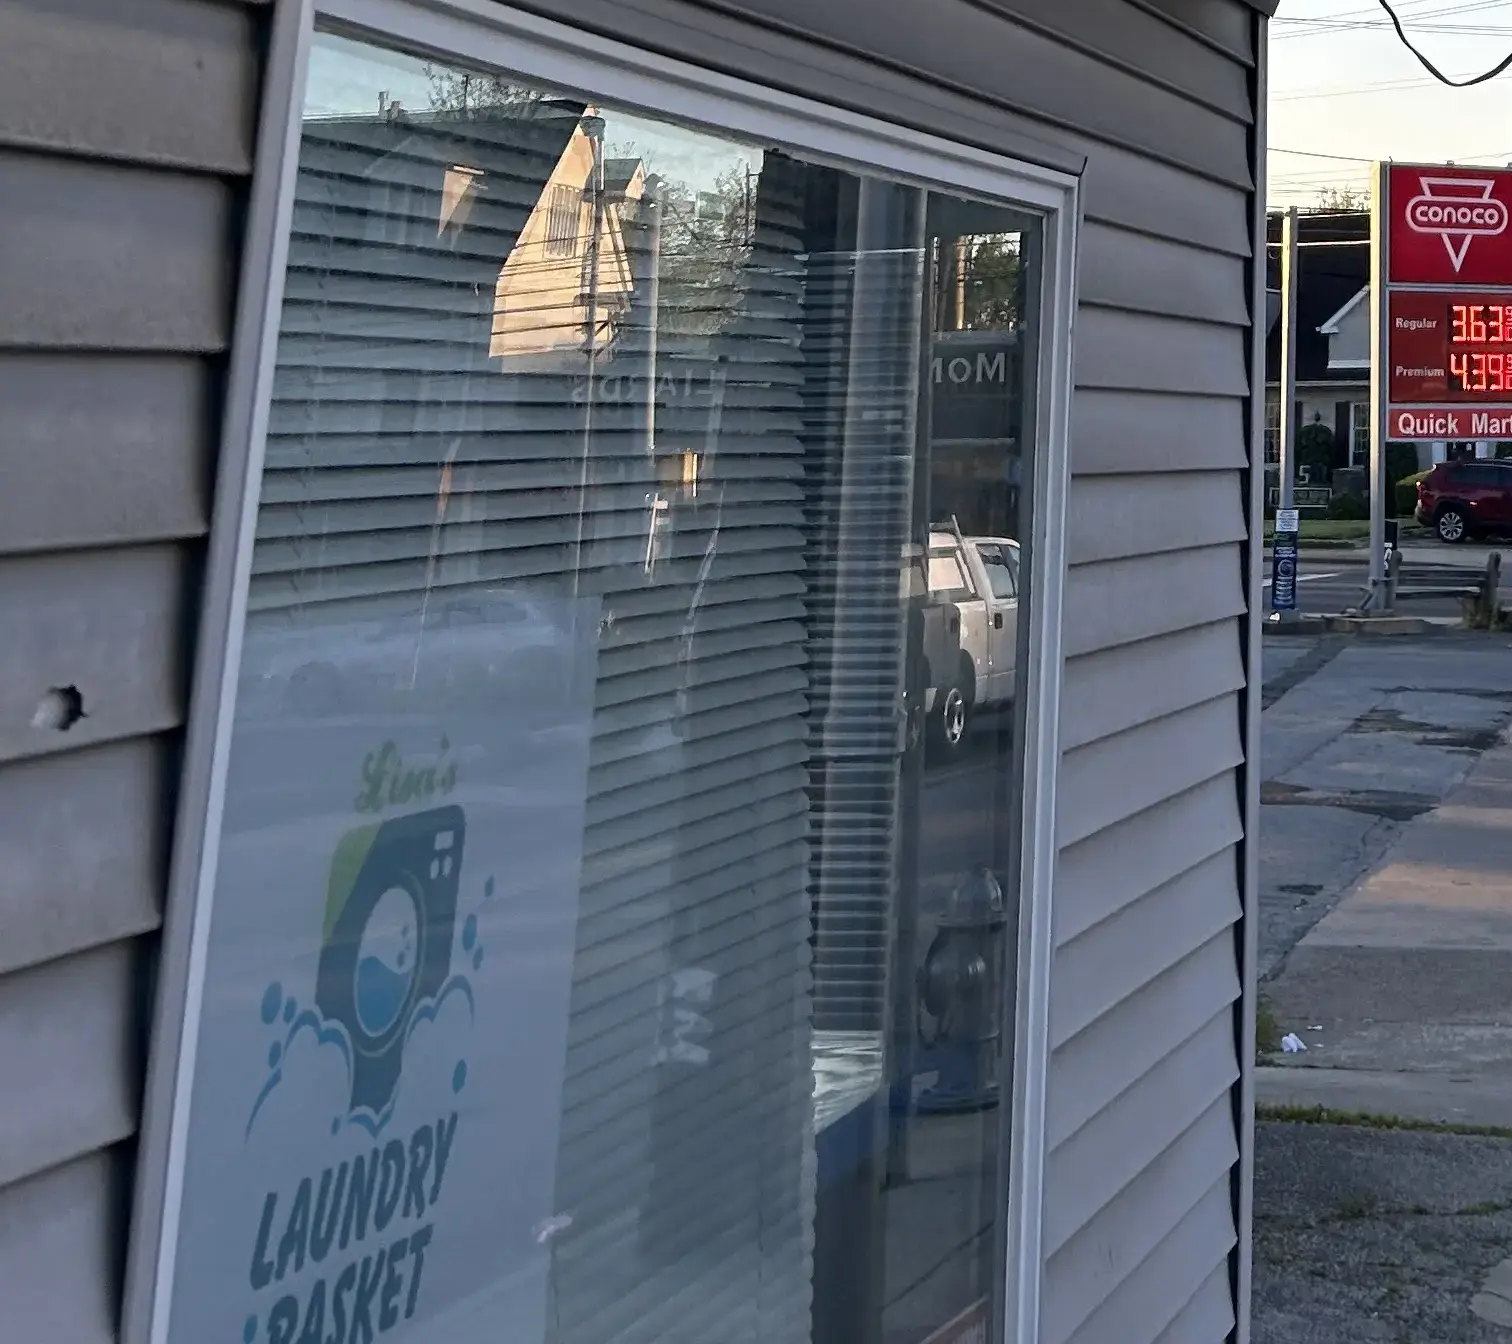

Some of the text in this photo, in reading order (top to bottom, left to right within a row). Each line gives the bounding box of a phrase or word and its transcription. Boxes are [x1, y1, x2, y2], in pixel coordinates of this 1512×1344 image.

[1395, 317, 1438, 330] Regular
[1395, 366, 1445, 378] Premium
[1398, 413, 1459, 436] Quick
[250, 1112, 459, 1290] LAUNDRY
[266, 1223, 435, 1344] BASKET
